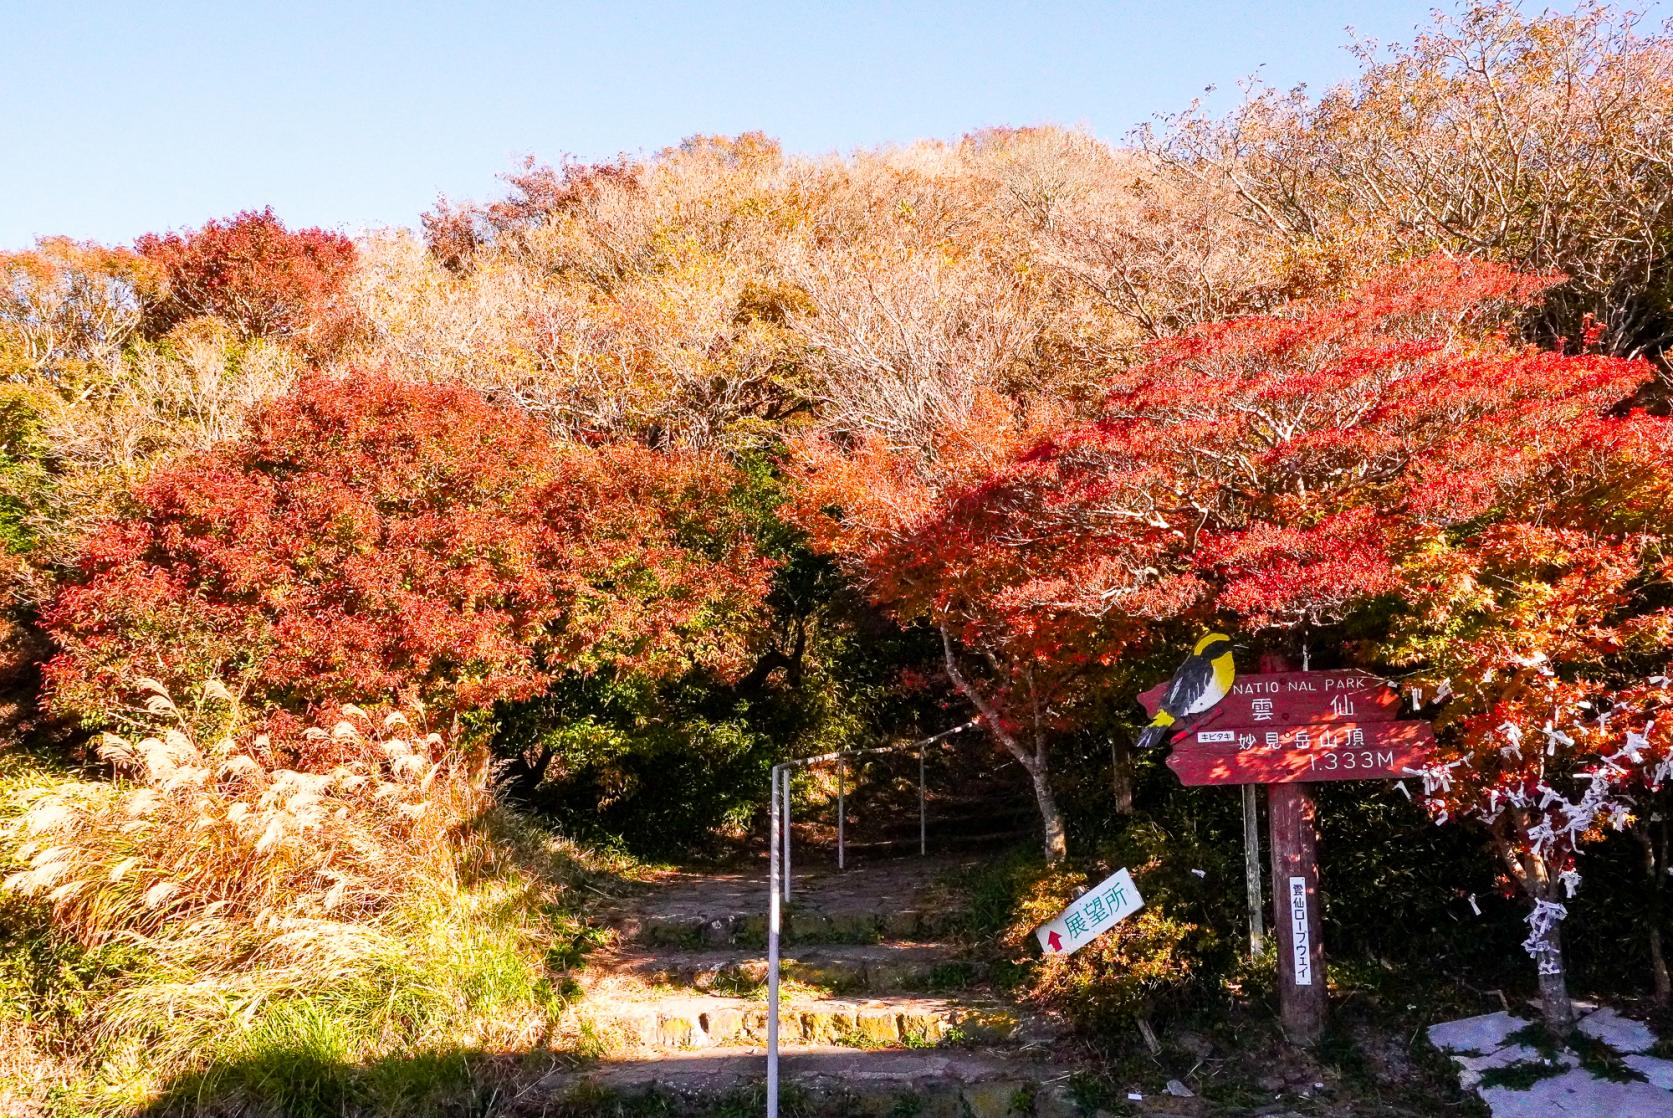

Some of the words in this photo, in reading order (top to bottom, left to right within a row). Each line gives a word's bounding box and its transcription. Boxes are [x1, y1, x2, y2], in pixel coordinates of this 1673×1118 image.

[1325, 677, 1365, 692] PARK
[1201, 732, 1231, 742] キビタキ
[1237, 727, 1365, 750] 妙見岳山頂
[1064, 882, 1127, 940] 展望所
